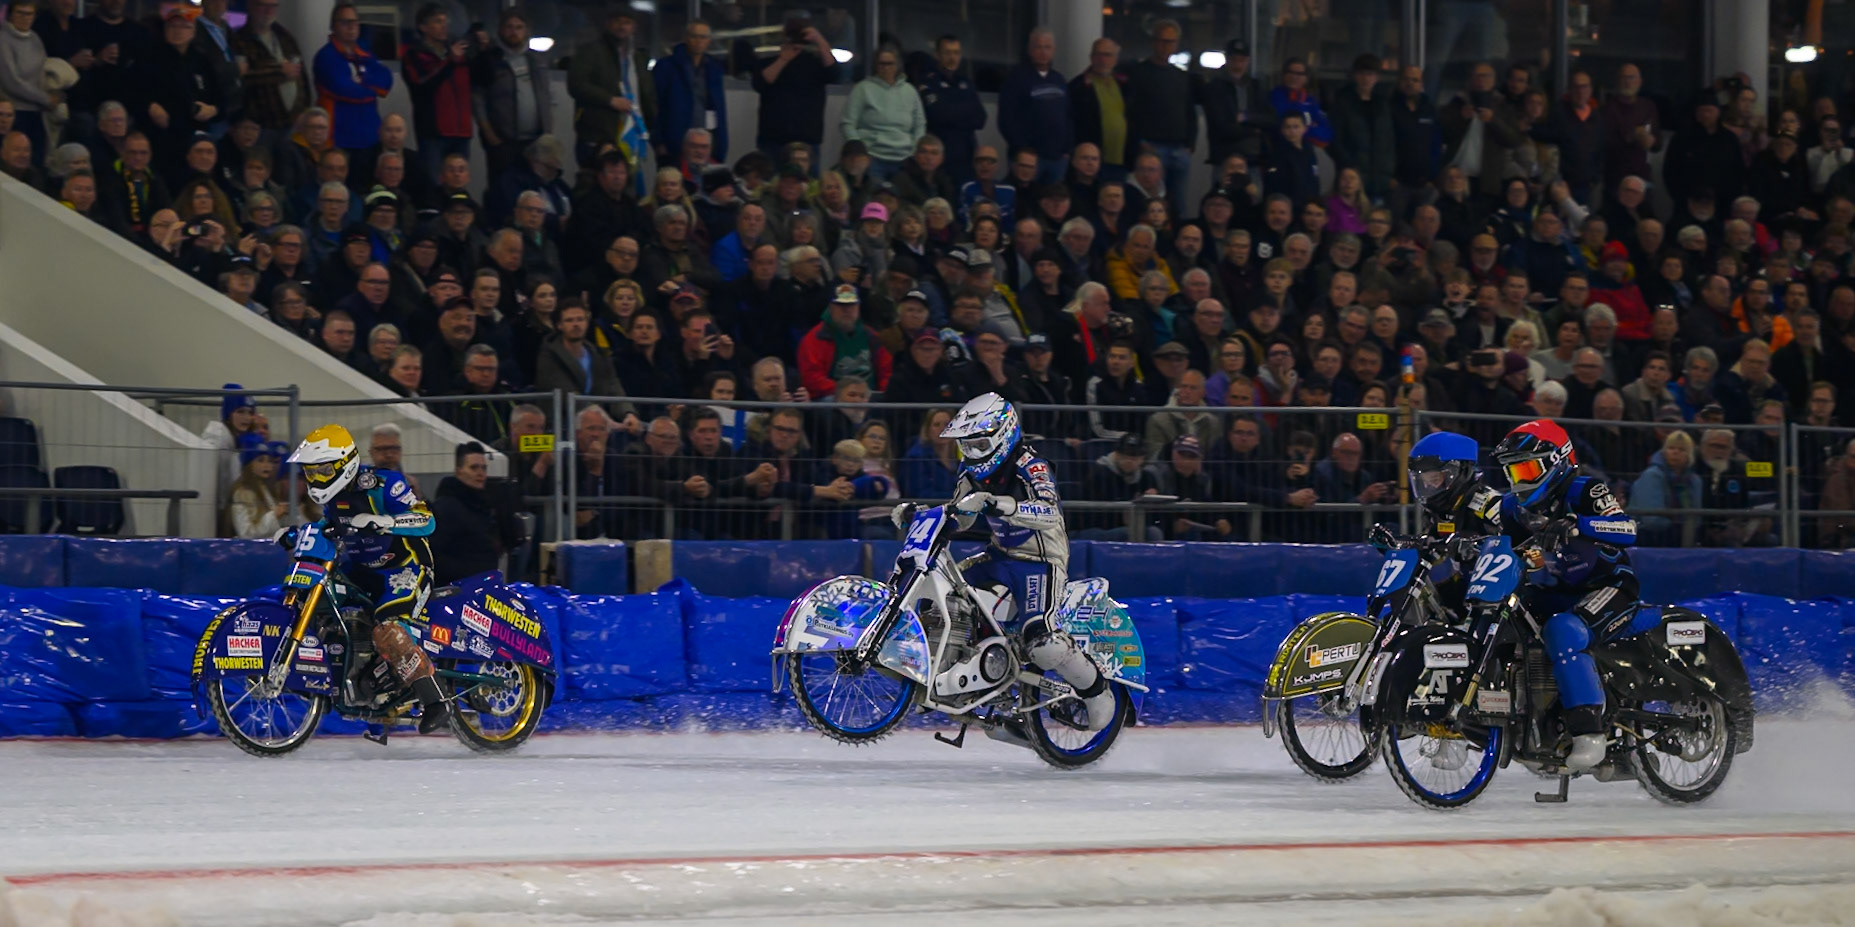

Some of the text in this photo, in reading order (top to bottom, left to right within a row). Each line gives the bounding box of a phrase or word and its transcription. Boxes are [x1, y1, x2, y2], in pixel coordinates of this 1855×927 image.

[1376, 559, 1406, 588] 67
[1470, 553, 1512, 583] 92
[463, 606, 492, 630] HACHER
[484, 594, 542, 639] THORWESTEN
[229, 638, 261, 648] HACHER
[263, 625, 280, 637] NK
[491, 621, 552, 666] BULLYLAND
[213, 657, 264, 670] THORWESTEN
